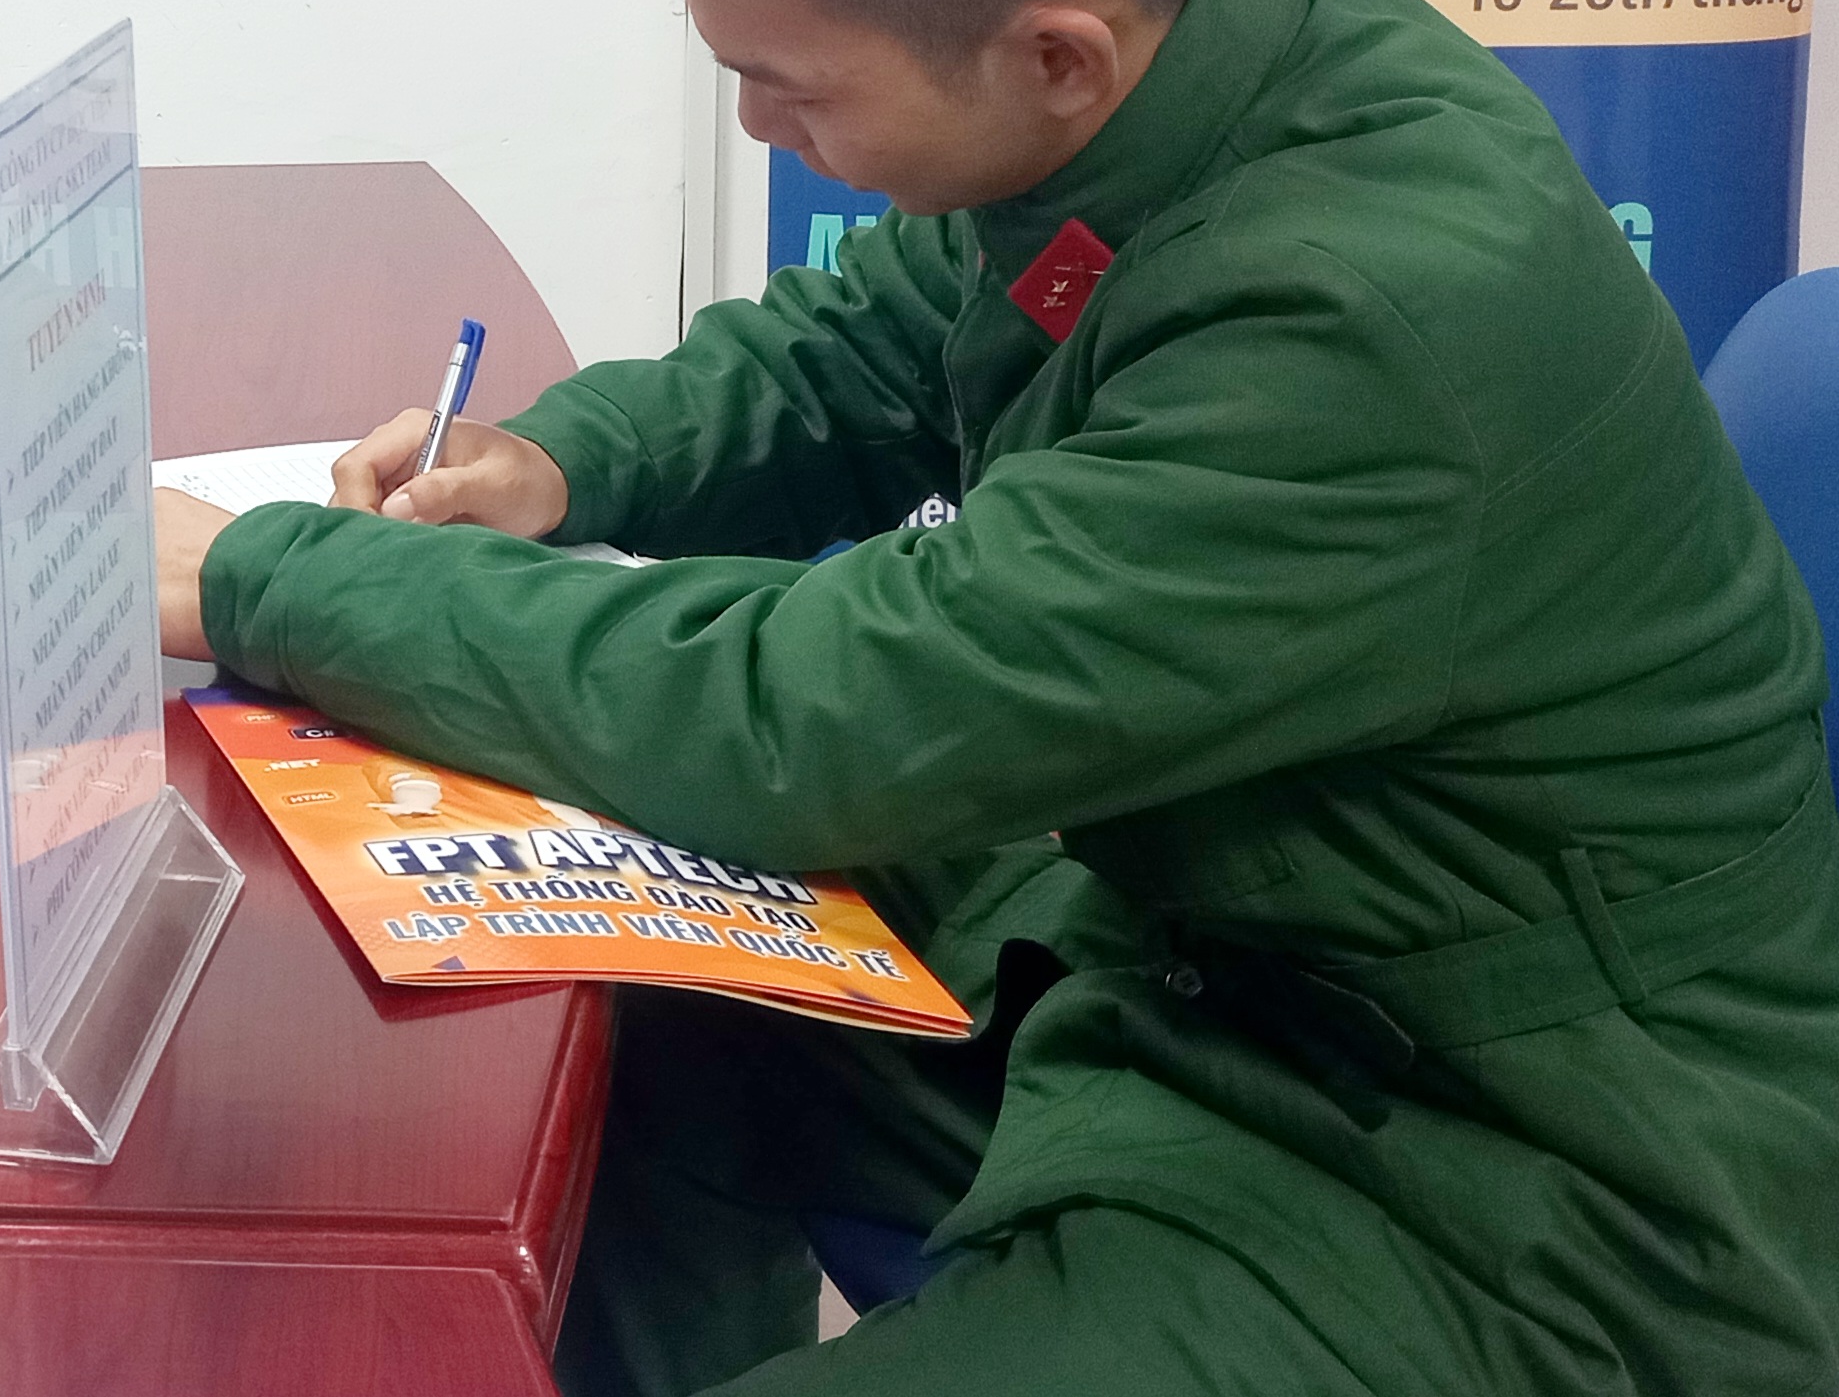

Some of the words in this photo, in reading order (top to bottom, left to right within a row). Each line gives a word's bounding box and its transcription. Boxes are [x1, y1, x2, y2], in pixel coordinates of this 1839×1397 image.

[264, 758, 321, 773] .NET
[290, 792, 335, 804] HTML
[364, 834, 510, 875] FPT
[529, 829, 818, 905] APTECH
[423, 879, 484, 907] HỆ
[490, 873, 637, 903] THỐNG
[644, 883, 731, 916] ĐÀO
[387, 913, 466, 942] LẬP
[480, 907, 616, 935] TRÌNH
[623, 913, 721, 946] VIÊN
[728, 930, 848, 968] QUỐC
[850, 950, 906, 980] TẾ
